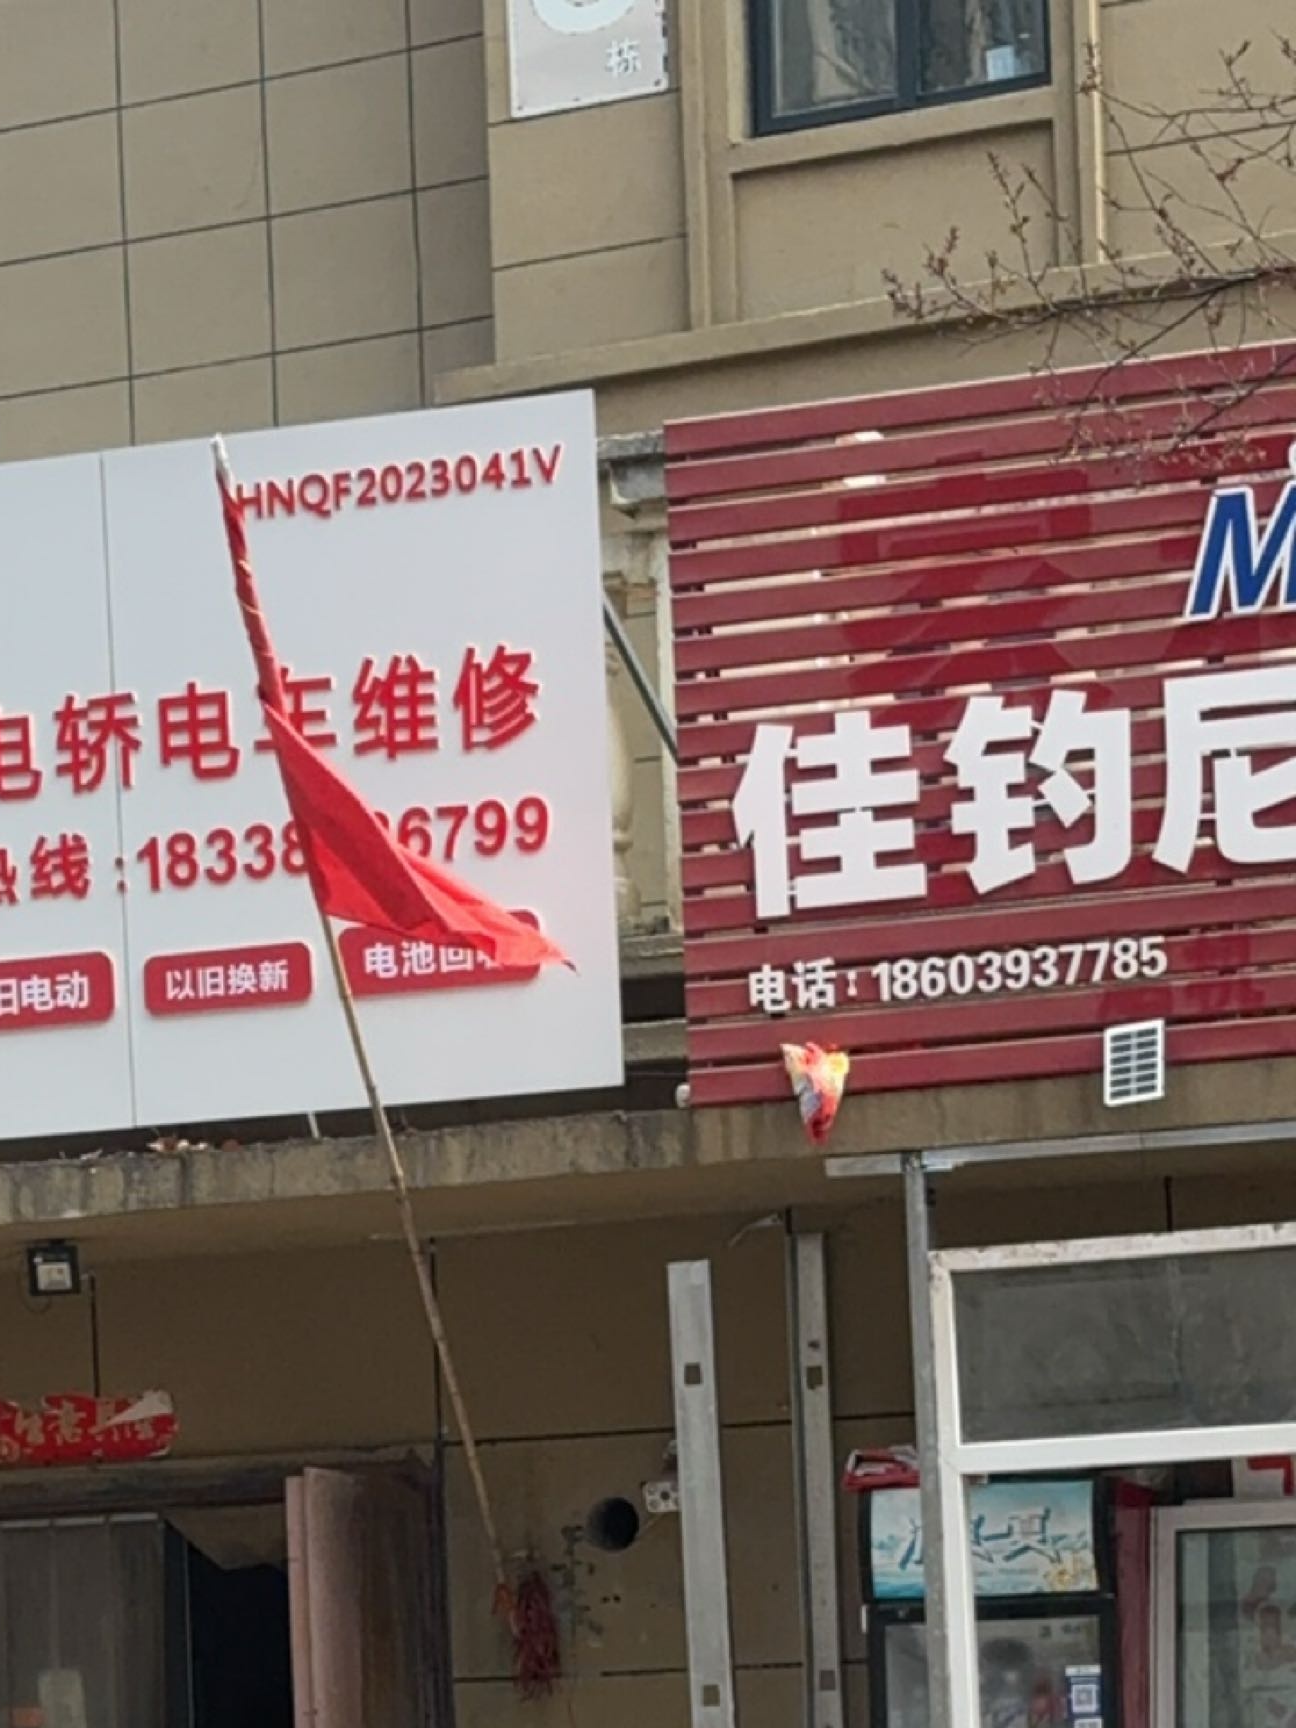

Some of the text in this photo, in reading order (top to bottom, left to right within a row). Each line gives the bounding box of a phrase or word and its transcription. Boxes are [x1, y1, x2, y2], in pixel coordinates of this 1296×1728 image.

[235, 444, 562, 520] HNQF2023041V
[732, 666, 1296, 919] 佳钓尼
[165, 959, 290, 1000] 以旧换新
[363, 940, 501, 979] 电池回
